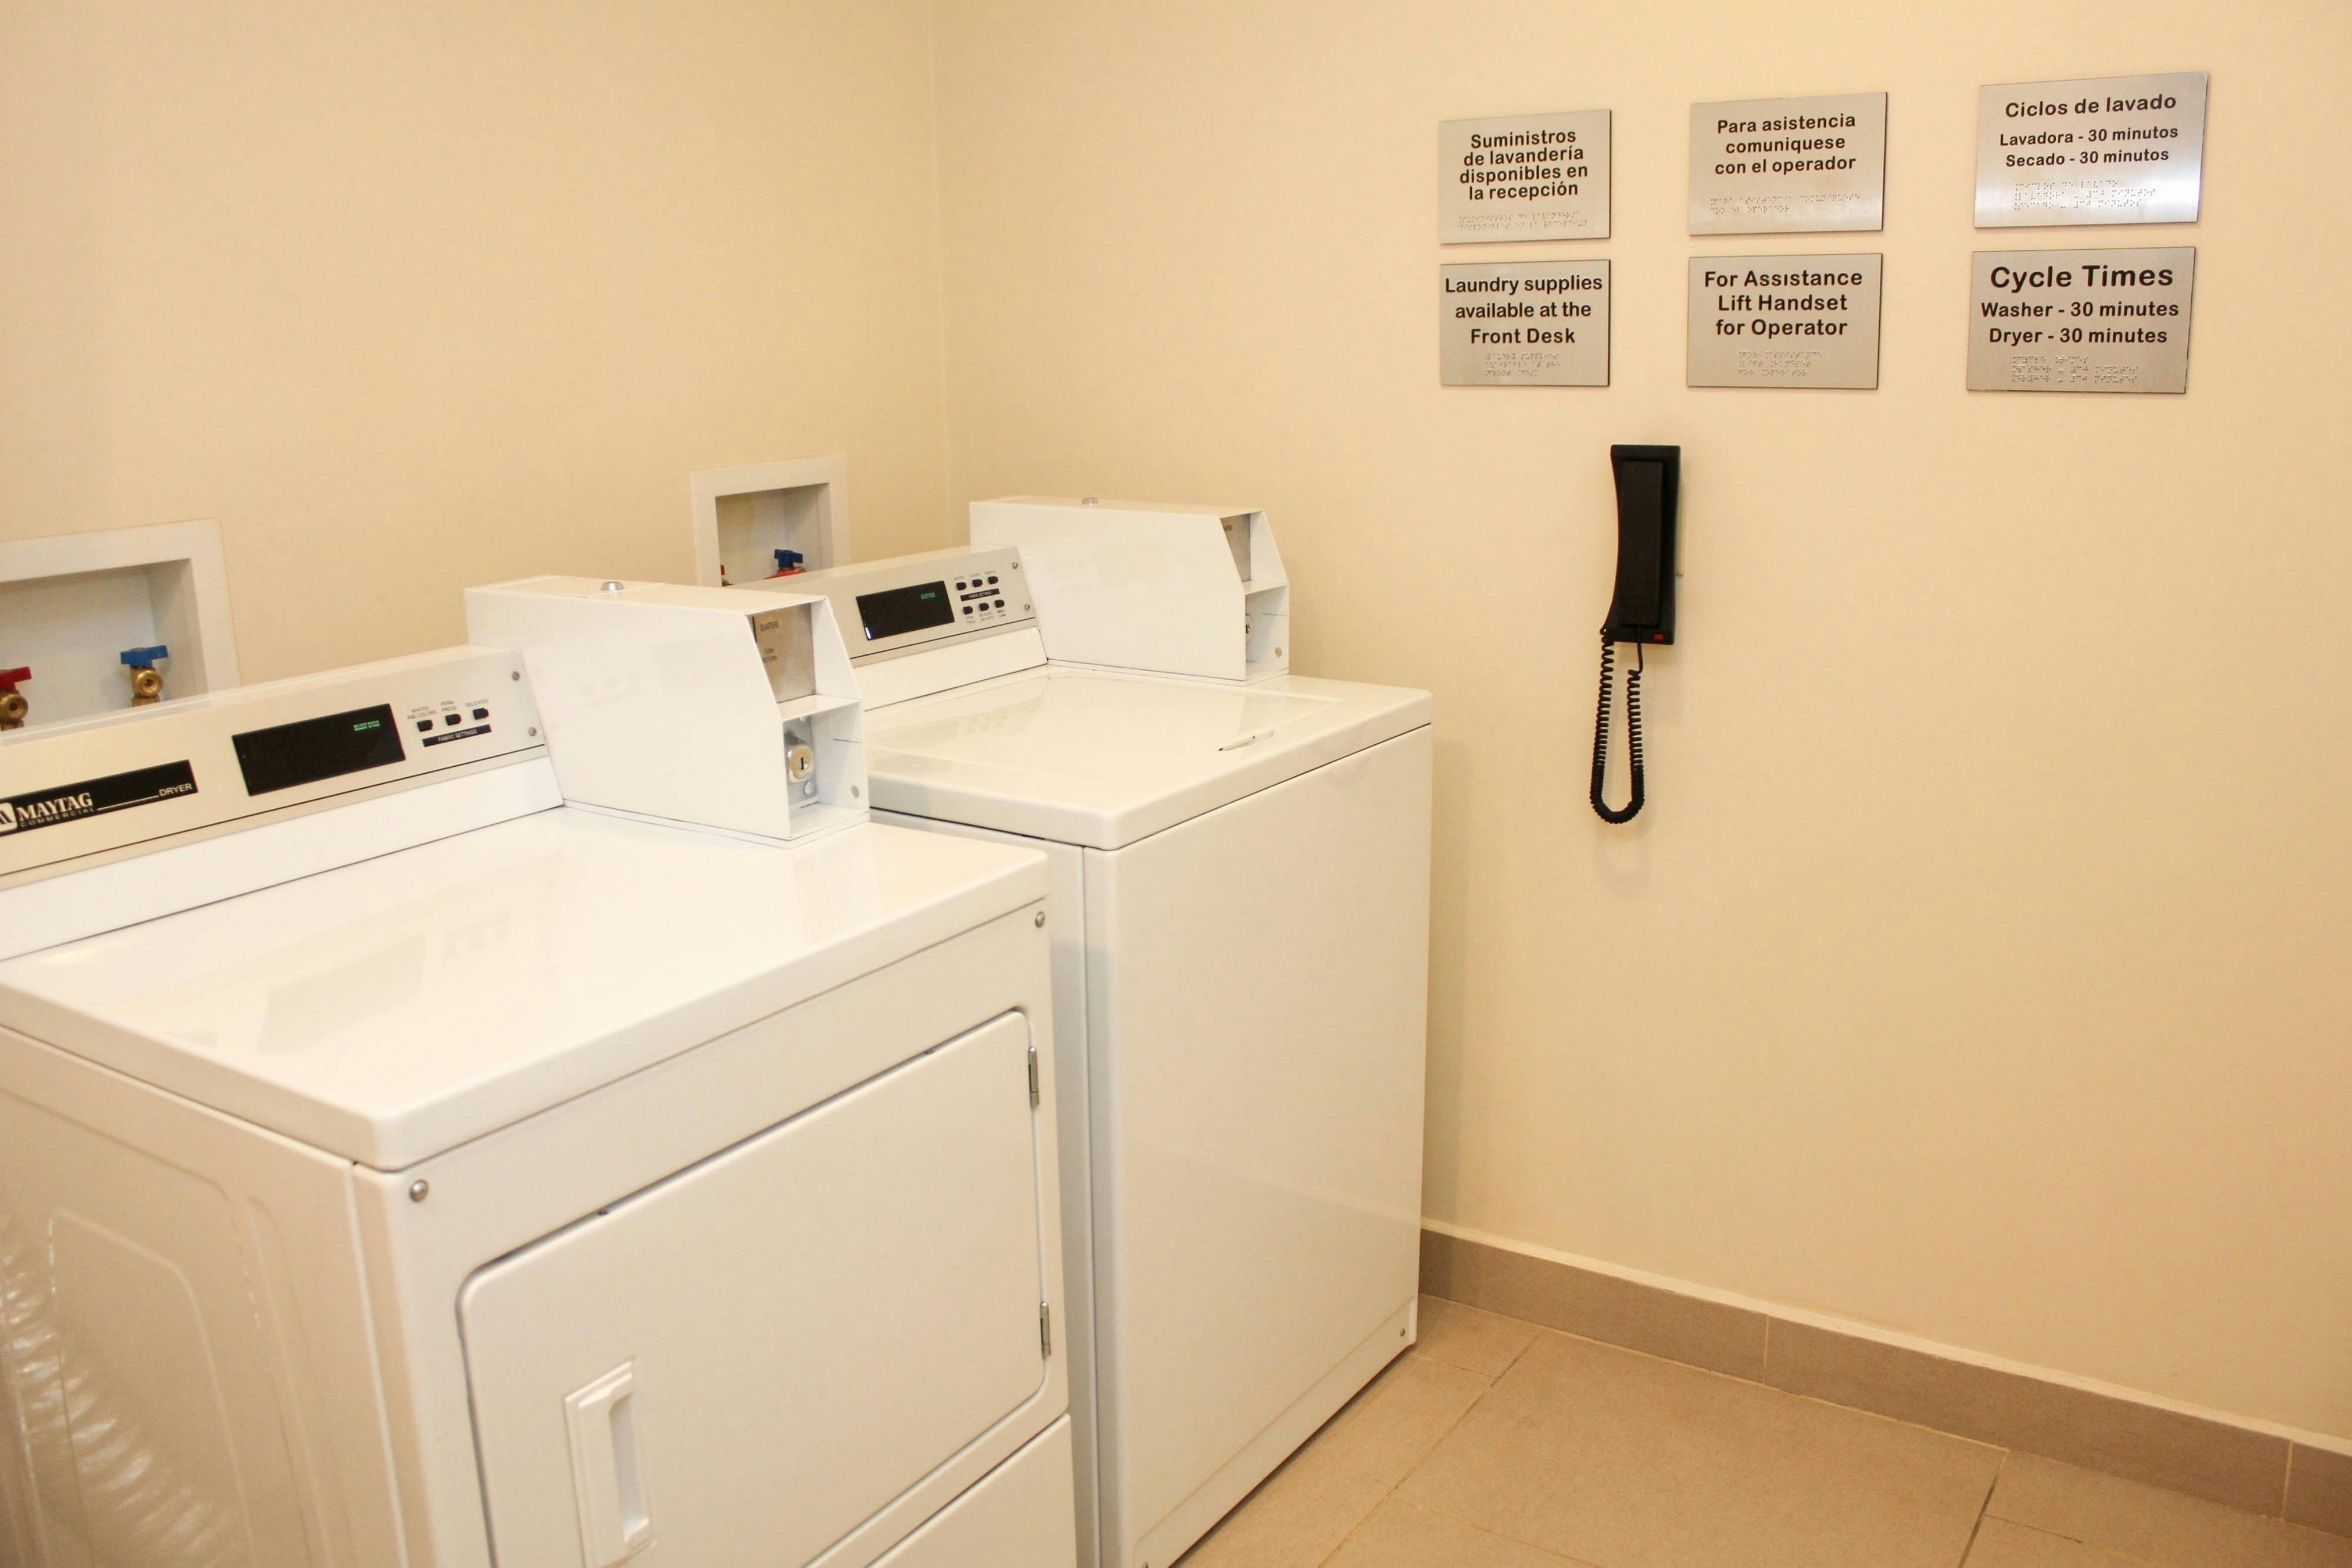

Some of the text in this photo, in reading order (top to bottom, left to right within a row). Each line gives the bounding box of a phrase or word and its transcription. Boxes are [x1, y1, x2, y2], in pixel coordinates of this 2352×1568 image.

[2005, 93, 2176, 118] Ciclos de lavado
[1718, 113, 1855, 134] Para asistencia
[1471, 130, 1576, 150] Suministros
[1726, 137, 1845, 154] comuniquese
[2000, 131, 2073, 146] Lavadora
[2088, 129, 2107, 142] 30
[2112, 126, 2178, 141] minutos
[1464, 145, 1583, 166] de lavandería
[1715, 155, 1856, 175] con el operador
[2006, 152, 2065, 167] Secado
[2079, 151, 2099, 164] 30
[2103, 149, 2169, 163] minutos
[1459, 164, 1588, 186] disponibles en
[1469, 180, 1578, 201] la recepción
[1445, 275, 1603, 296] Laundry supplies
[1705, 270, 1862, 287] For Assistance
[1990, 265, 2173, 293] Cycle Times
[1455, 301, 1591, 319] available at the
[1718, 294, 1847, 311] Lift Handset
[1981, 302, 2053, 317] Washer
[2070, 301, 2093, 317] 30
[2099, 301, 2179, 317] minutes
[1471, 327, 1575, 344] Front Desk
[1715, 319, 1848, 339] for Operator
[1989, 327, 2043, 347] Dryer
[2060, 327, 2083, 343] 30
[2089, 327, 2167, 343] minutes
[158, 782, 193, 797] DRYER
[16, 793, 93, 821] MAYTAG
[19, 808, 94, 827] COMMERCIAL
